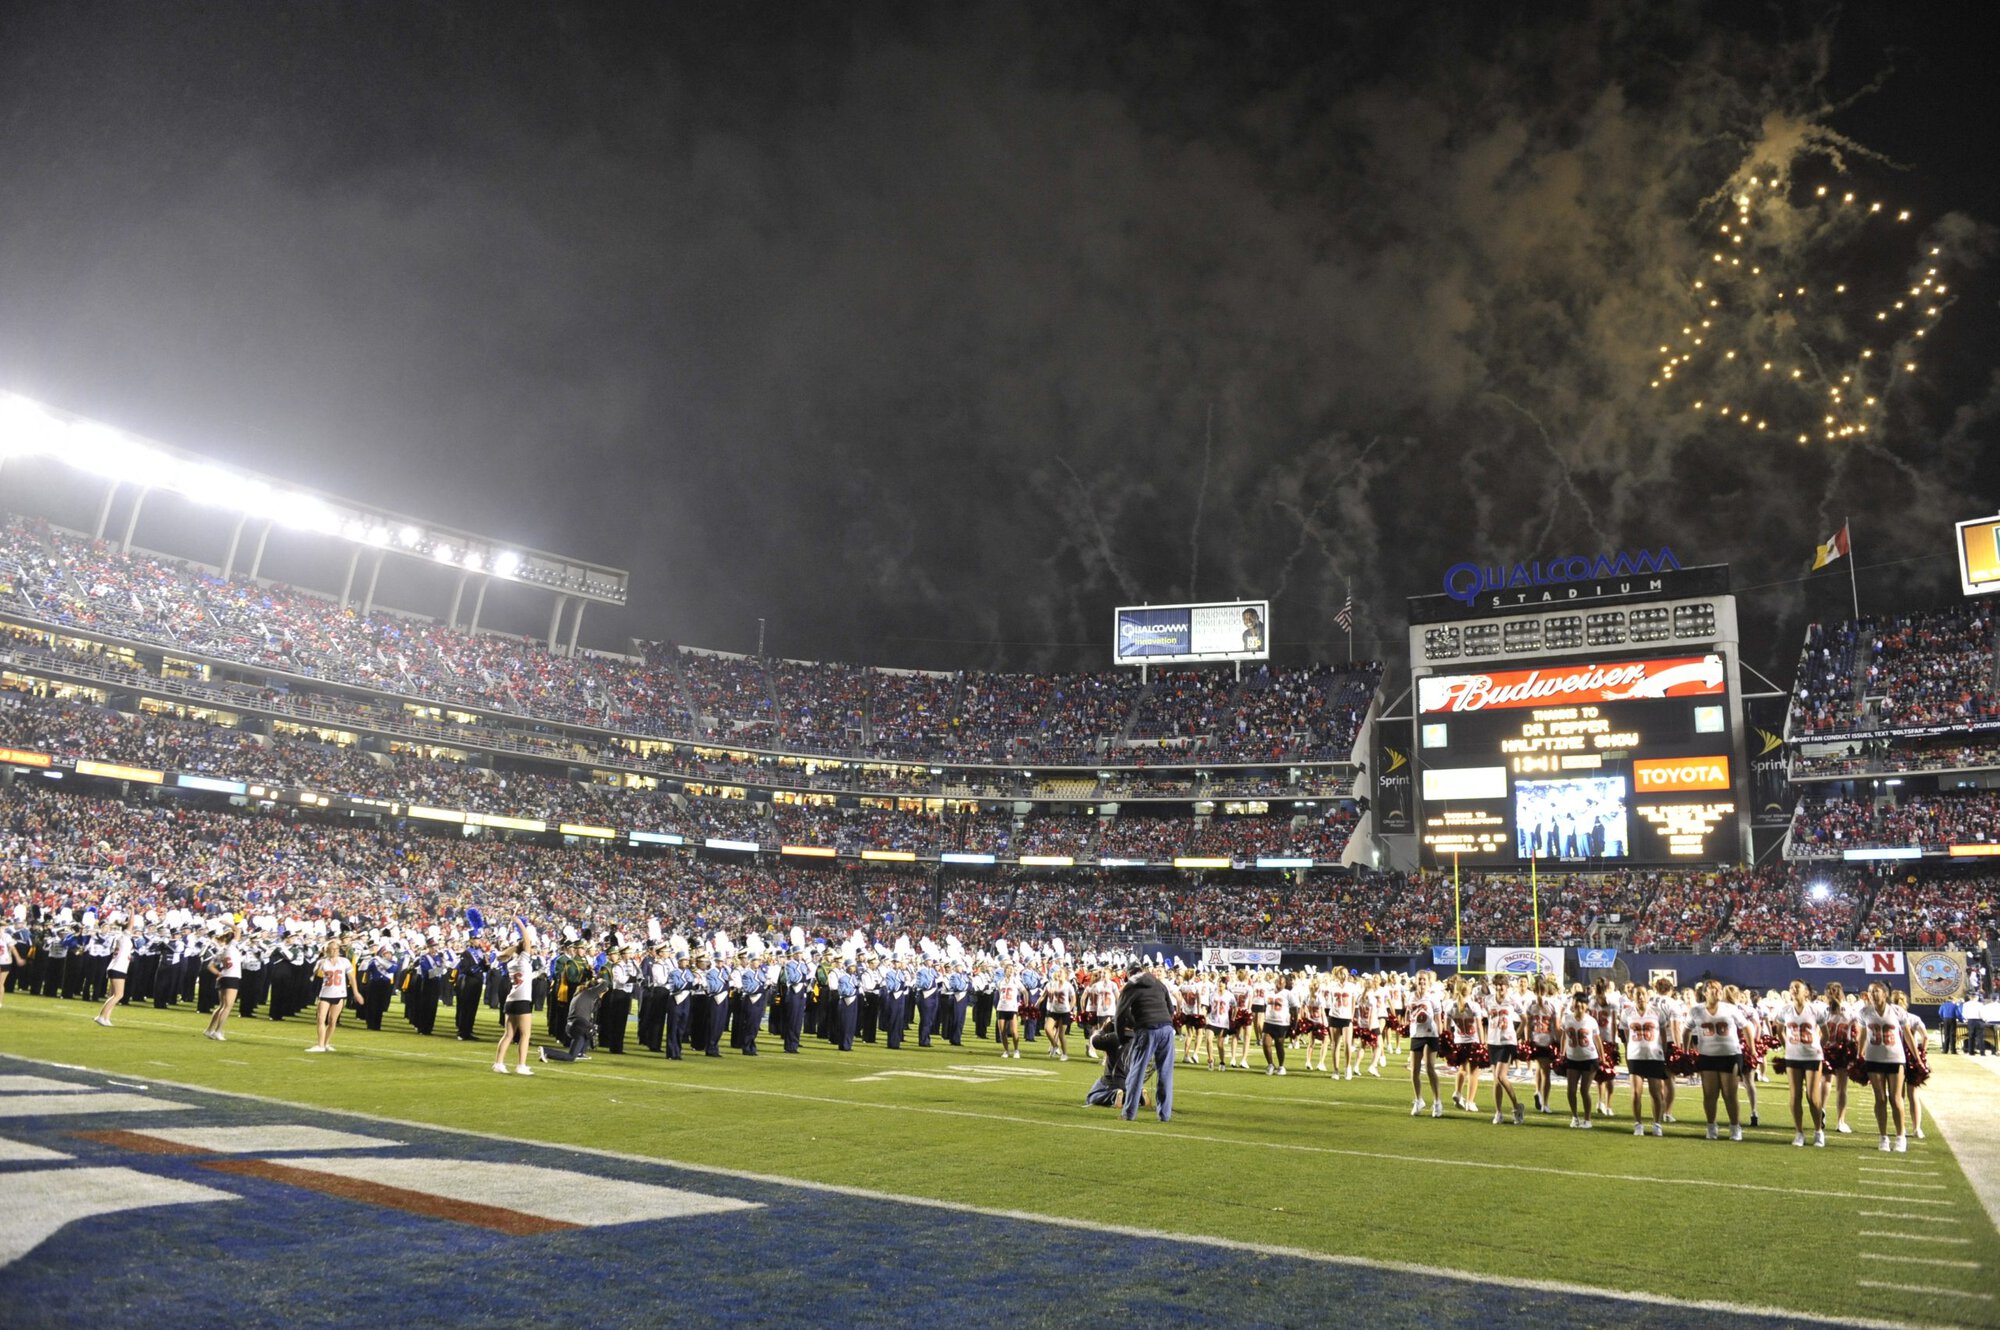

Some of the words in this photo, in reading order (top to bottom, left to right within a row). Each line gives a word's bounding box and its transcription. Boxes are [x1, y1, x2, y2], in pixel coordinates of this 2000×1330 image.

[1443, 547, 1681, 607] QUALCOMM
[1493, 579, 1662, 606] STADIUM
[1122, 624, 1188, 639] QUALCOMM
[1448, 664, 1646, 713] Budweiser
[1581, 706, 1599, 718] TO
[1522, 723, 1545, 737] DR
[1550, 719, 1610, 735] PEPPER
[1811, 735, 1823, 743] FAN
[1823, 732, 1851, 741] CONDUCT
[1851, 729, 1874, 739] ISSUES,
[1874, 728, 1889, 737] TEXT
[1501, 736, 1585, 752] HALFTIME
[1594, 732, 1639, 748] SHOW
[1751, 759, 1788, 771] Sprint
[1380, 775, 1410, 787] Sprint
[1638, 766, 1725, 785] TOYOTA
[1209, 950, 1223, 964] A
[1504, 953, 1530, 963] PACIFIC
[1872, 954, 1896, 972] N
[324, 970, 343, 986] 36
[1567, 1027, 1589, 1048] 36
[1630, 1021, 1655, 1042] 36
[1787, 1022, 1813, 1045] 36
[1868, 1023, 1896, 1046] 36
